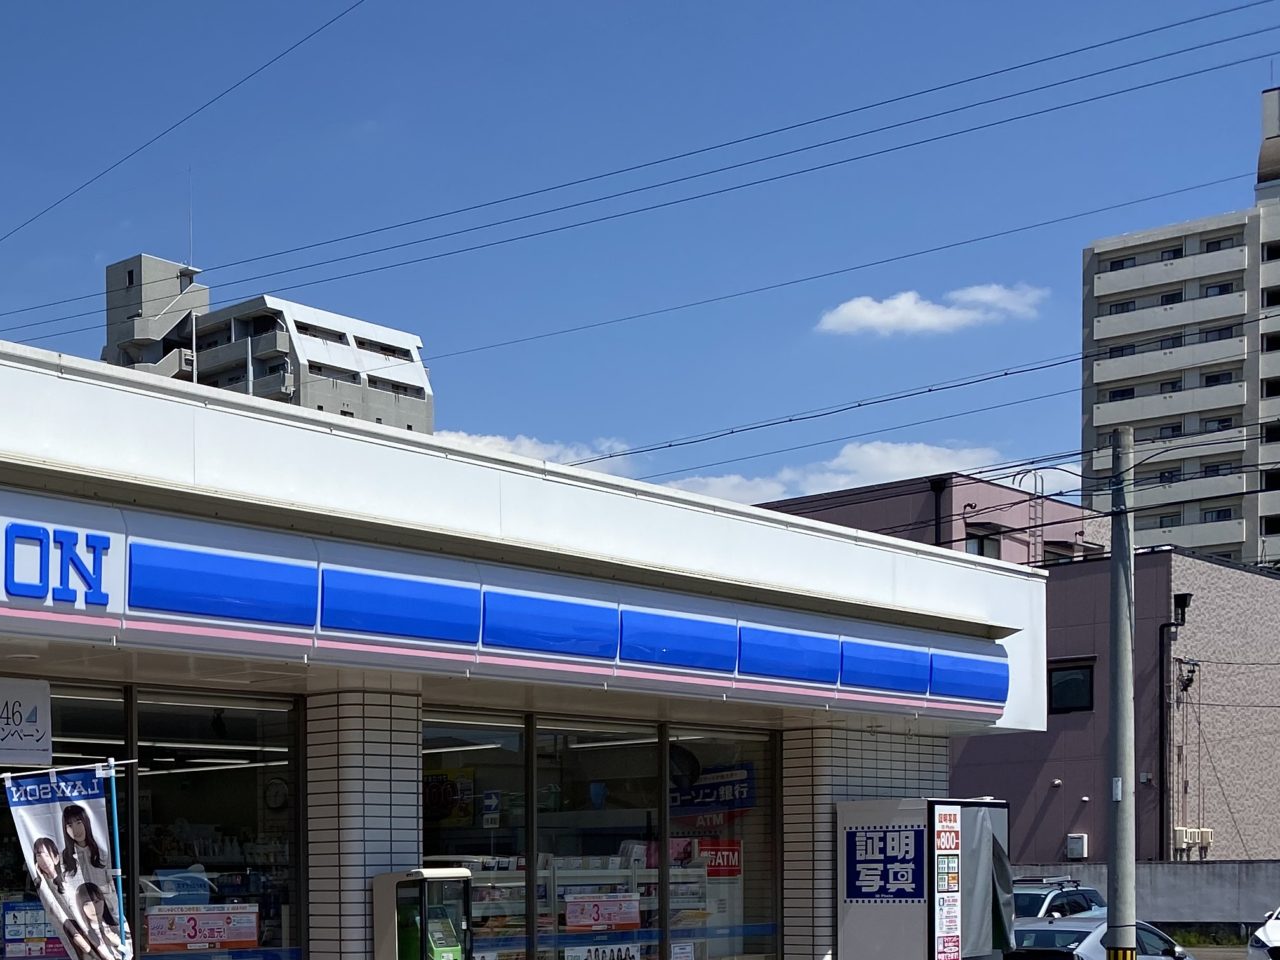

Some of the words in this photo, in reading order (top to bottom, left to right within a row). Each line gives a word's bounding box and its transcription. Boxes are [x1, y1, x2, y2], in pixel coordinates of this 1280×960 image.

[696, 813, 724, 827] ATM
[856, 831, 915, 860] 証明
[856, 861, 916, 893] 写真
